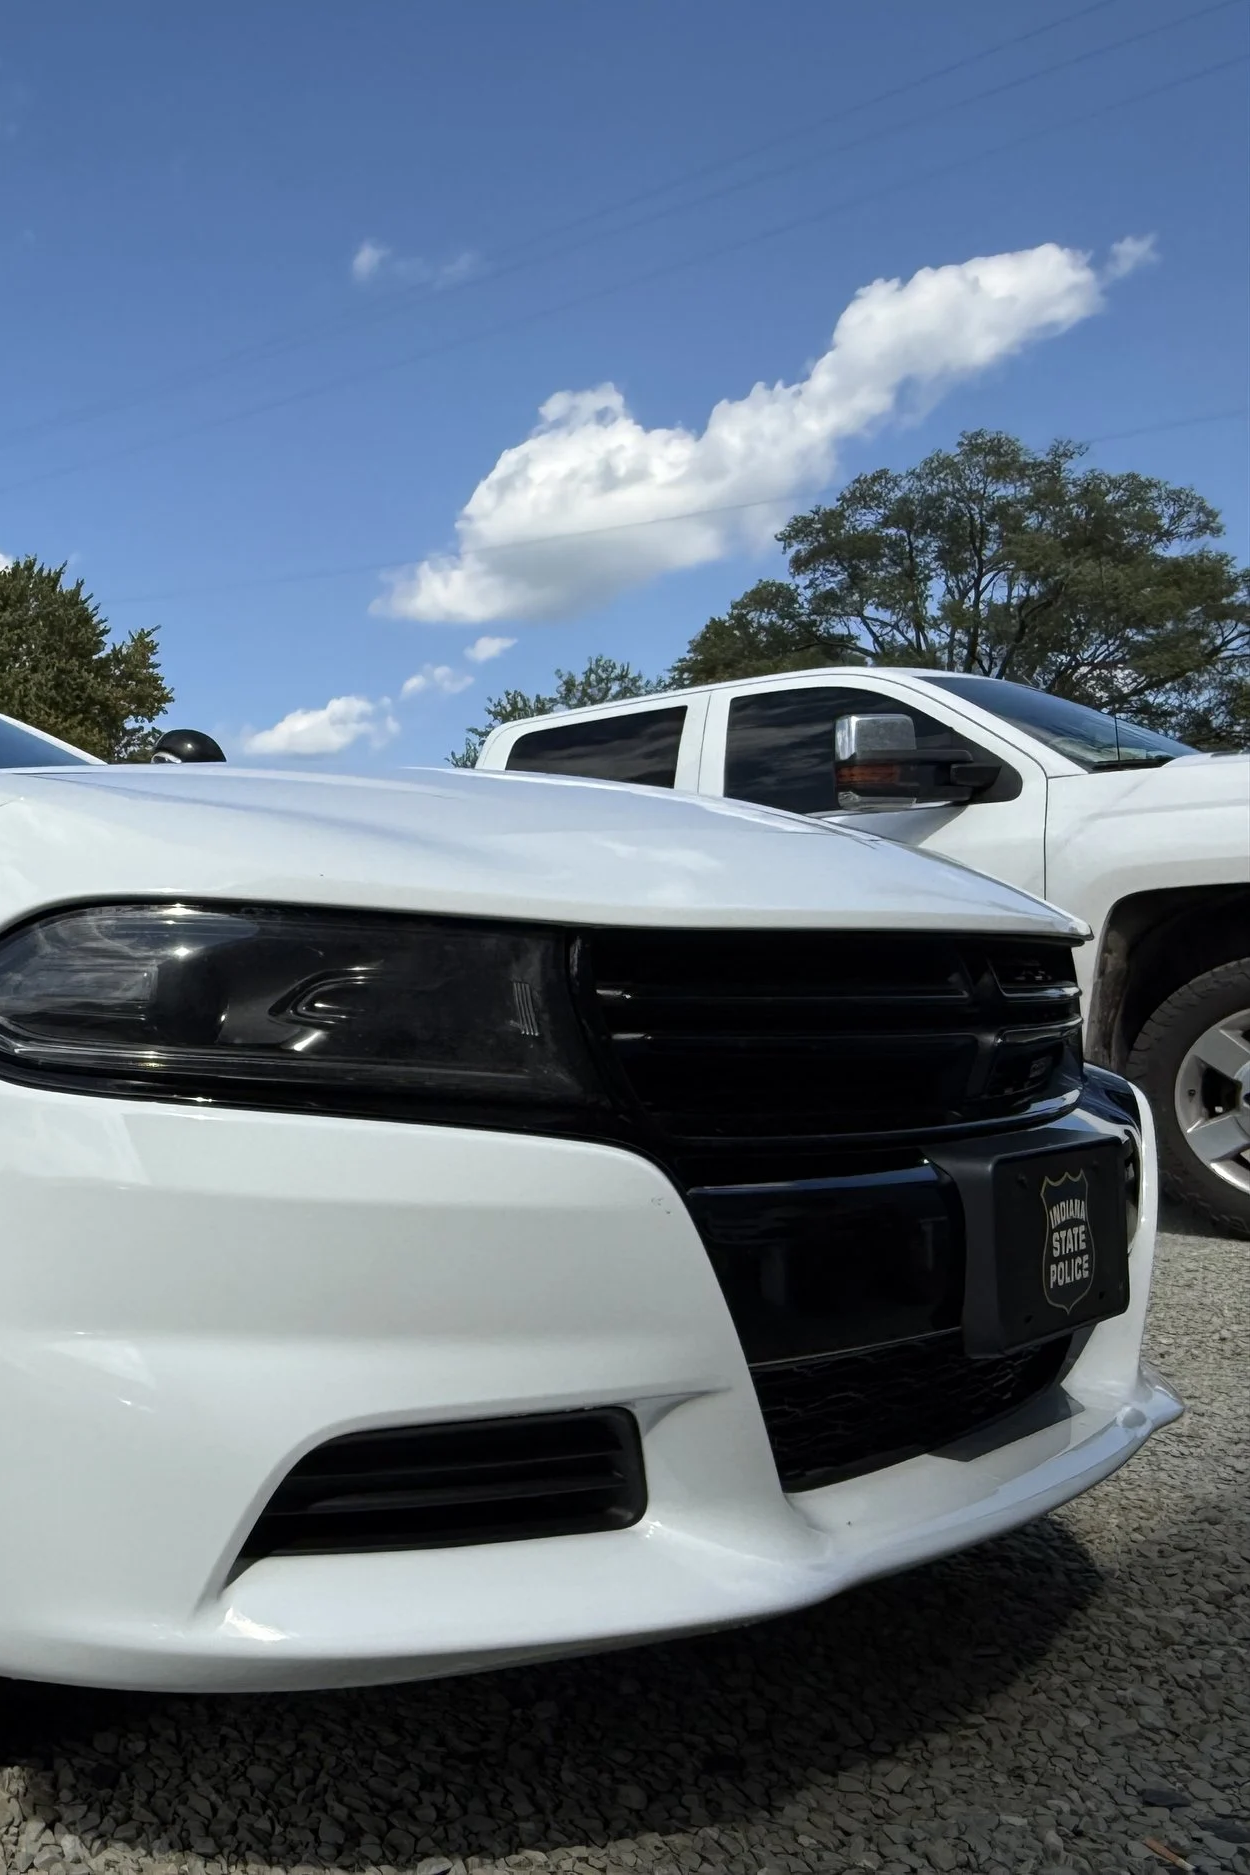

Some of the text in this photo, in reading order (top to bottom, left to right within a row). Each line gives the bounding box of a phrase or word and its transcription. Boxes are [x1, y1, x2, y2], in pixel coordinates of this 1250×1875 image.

[1050, 1198, 1086, 1230] INDIANA
[1052, 1224, 1087, 1258] STATE
[1050, 1254, 1090, 1289] POLICE
